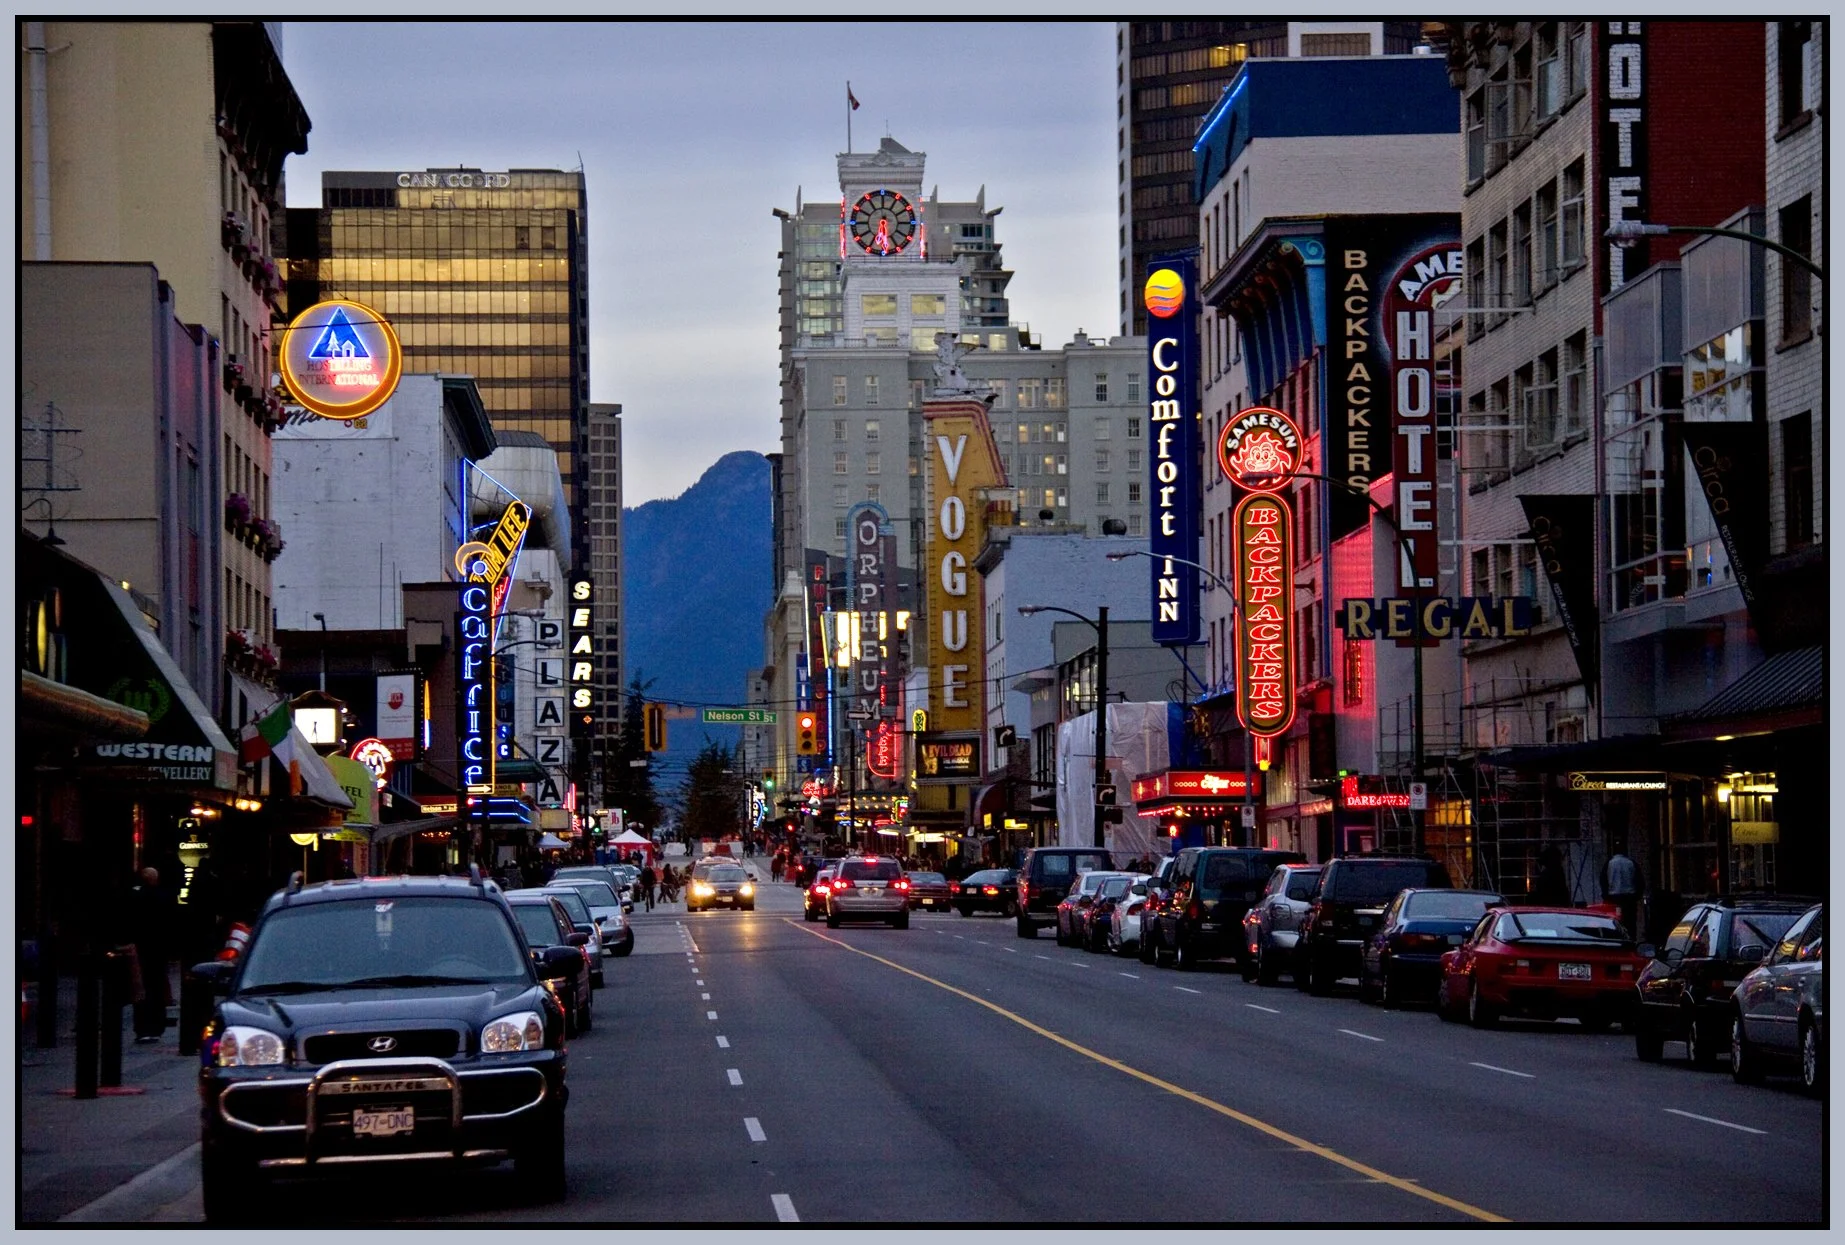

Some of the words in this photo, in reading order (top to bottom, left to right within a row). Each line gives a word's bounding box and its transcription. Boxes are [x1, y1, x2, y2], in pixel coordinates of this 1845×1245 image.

[397, 173, 510, 187] CANACCORD
[299, 374, 379, 385] INTERNATIONAL
[306, 359, 372, 371] HOSTELLING
[1344, 250, 1371, 494] BACKPACKERS
[1151, 338, 1181, 535] Comfort
[1226, 414, 1297, 449] SAMESUN
[1396, 311, 1434, 587] HOTEL
[498, 507, 527, 551] LEE
[936, 435, 968, 708] VOGUE
[858, 521, 881, 720] ORPHEUM
[1246, 508, 1284, 718] BACKPACKERS
[1347, 600, 1530, 638] REGAL
[573, 581, 592, 708] SEARS
[540, 623, 562, 802] PLAZA
[708, 711, 744, 720] Nelson
[749, 711, 760, 720] St
[764, 714, 773, 722] St
[97, 743, 213, 762] WESTERN
[929, 745, 948, 757] EVIL
[949, 744, 972, 757] DEAD
[354, 1113, 414, 1130] 497-DNC
